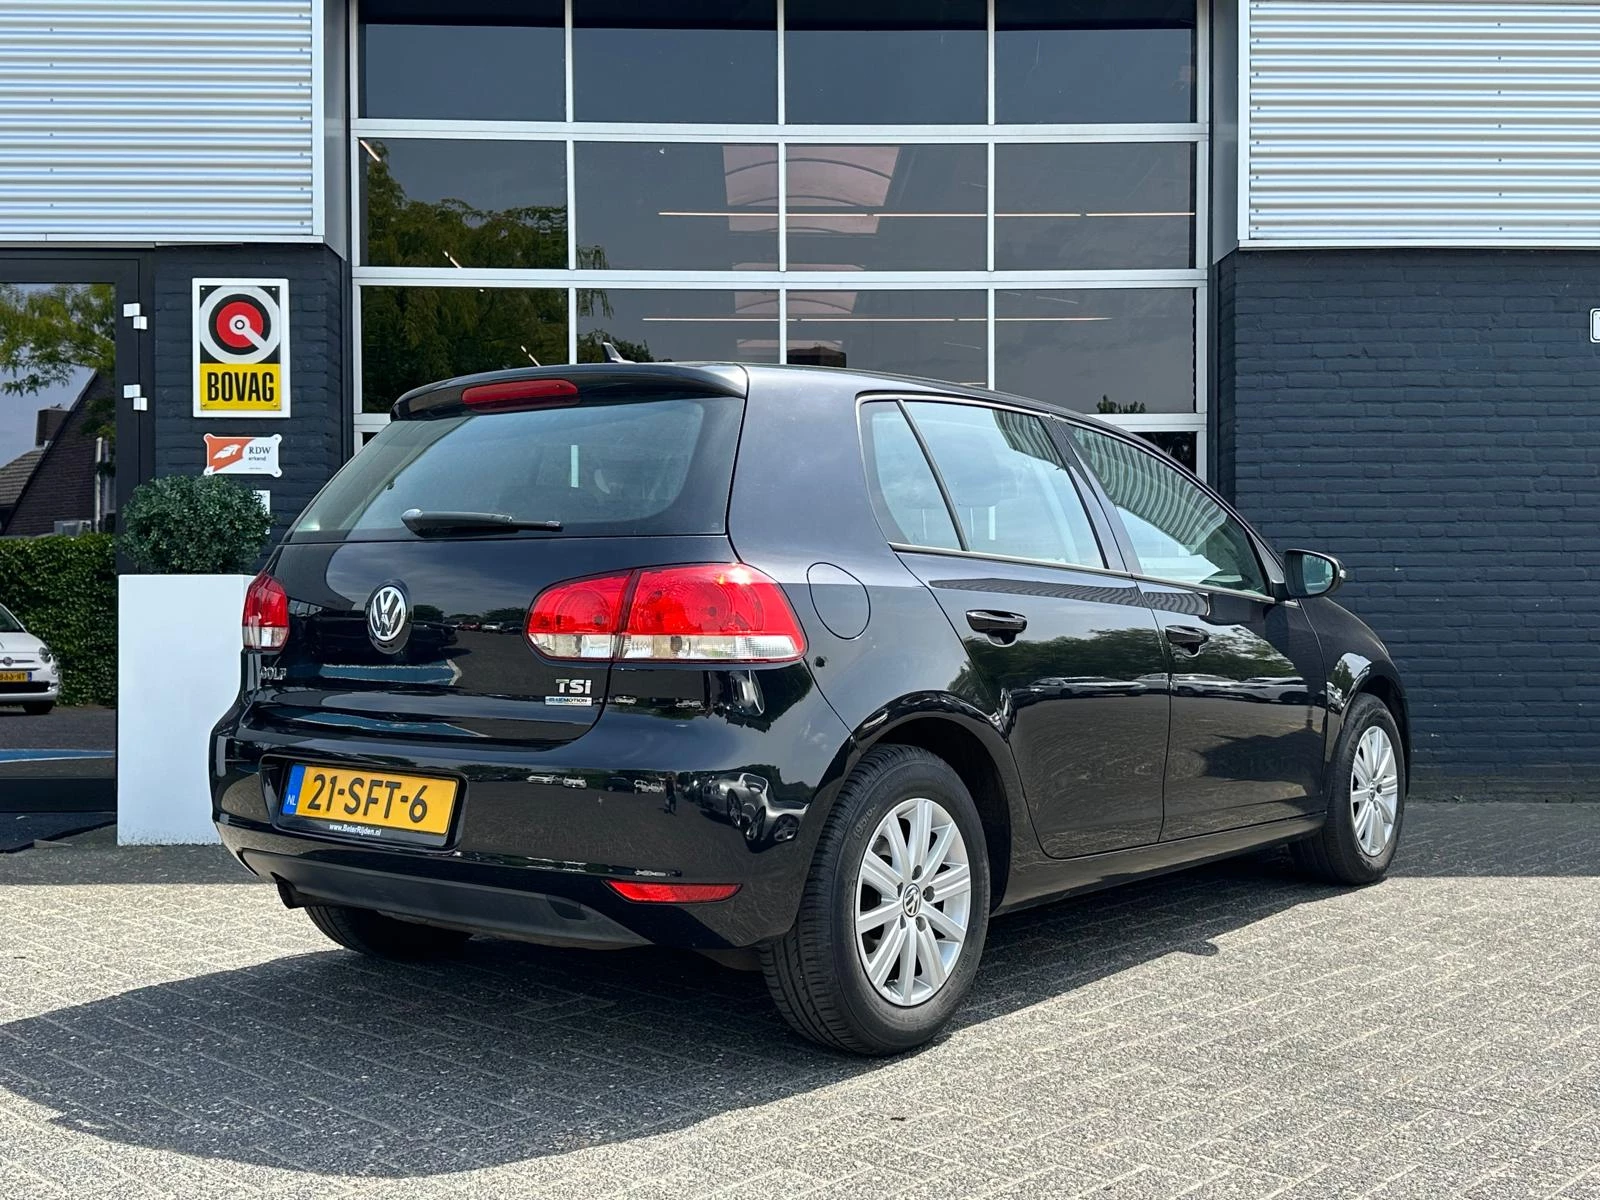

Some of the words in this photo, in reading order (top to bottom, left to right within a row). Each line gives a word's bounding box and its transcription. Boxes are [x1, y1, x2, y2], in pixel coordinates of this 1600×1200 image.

[207, 372, 275, 402] BOVAG
[248, 446, 271, 455] RDW
[555, 679, 592, 694] TSI
[286, 794, 297, 806] NL
[307, 773, 428, 823] 21-SFT-6
